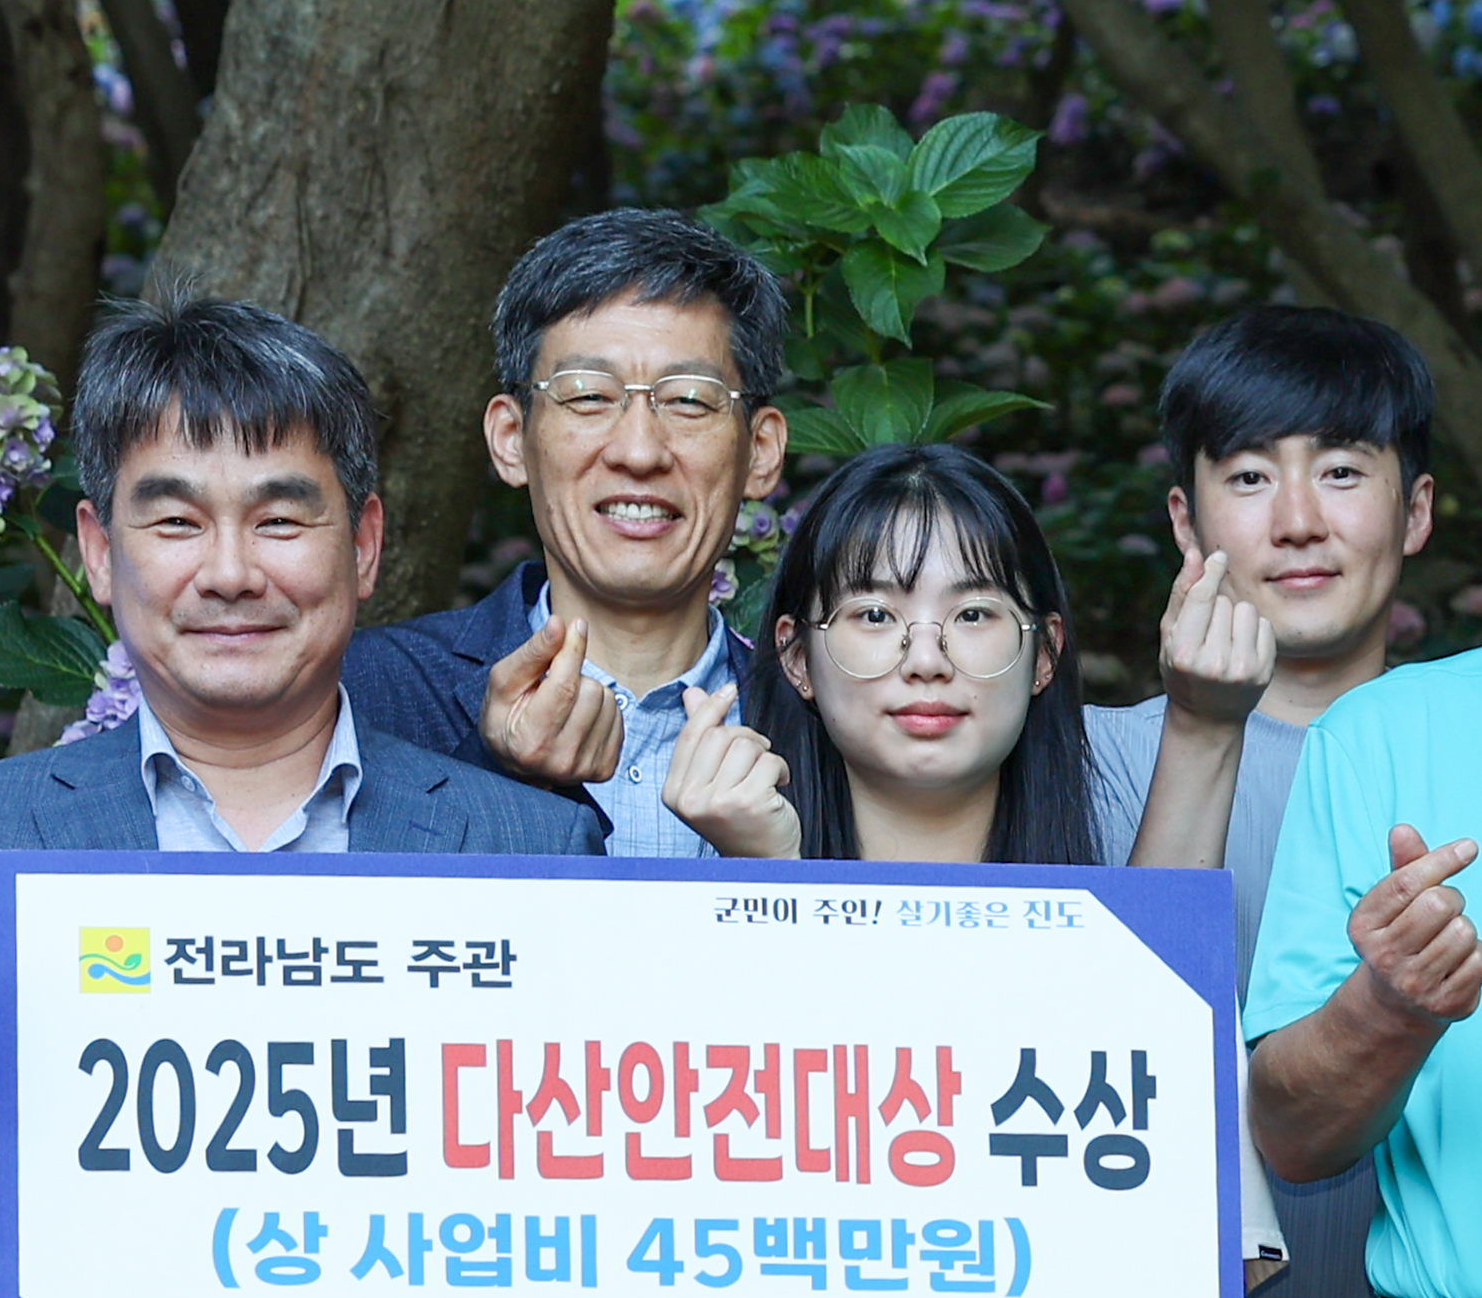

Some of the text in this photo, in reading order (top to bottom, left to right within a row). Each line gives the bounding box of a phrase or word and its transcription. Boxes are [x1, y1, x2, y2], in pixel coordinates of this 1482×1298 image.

[716, 898, 1086, 929] 군민이 주인! 살기좋은 진도
[164, 936, 517, 988] 전라남도 주관
[78, 1038, 1156, 1191] 2025년 다산안전대상 수상
[213, 1208, 1031, 1297] (상 사업비 45백만원)
